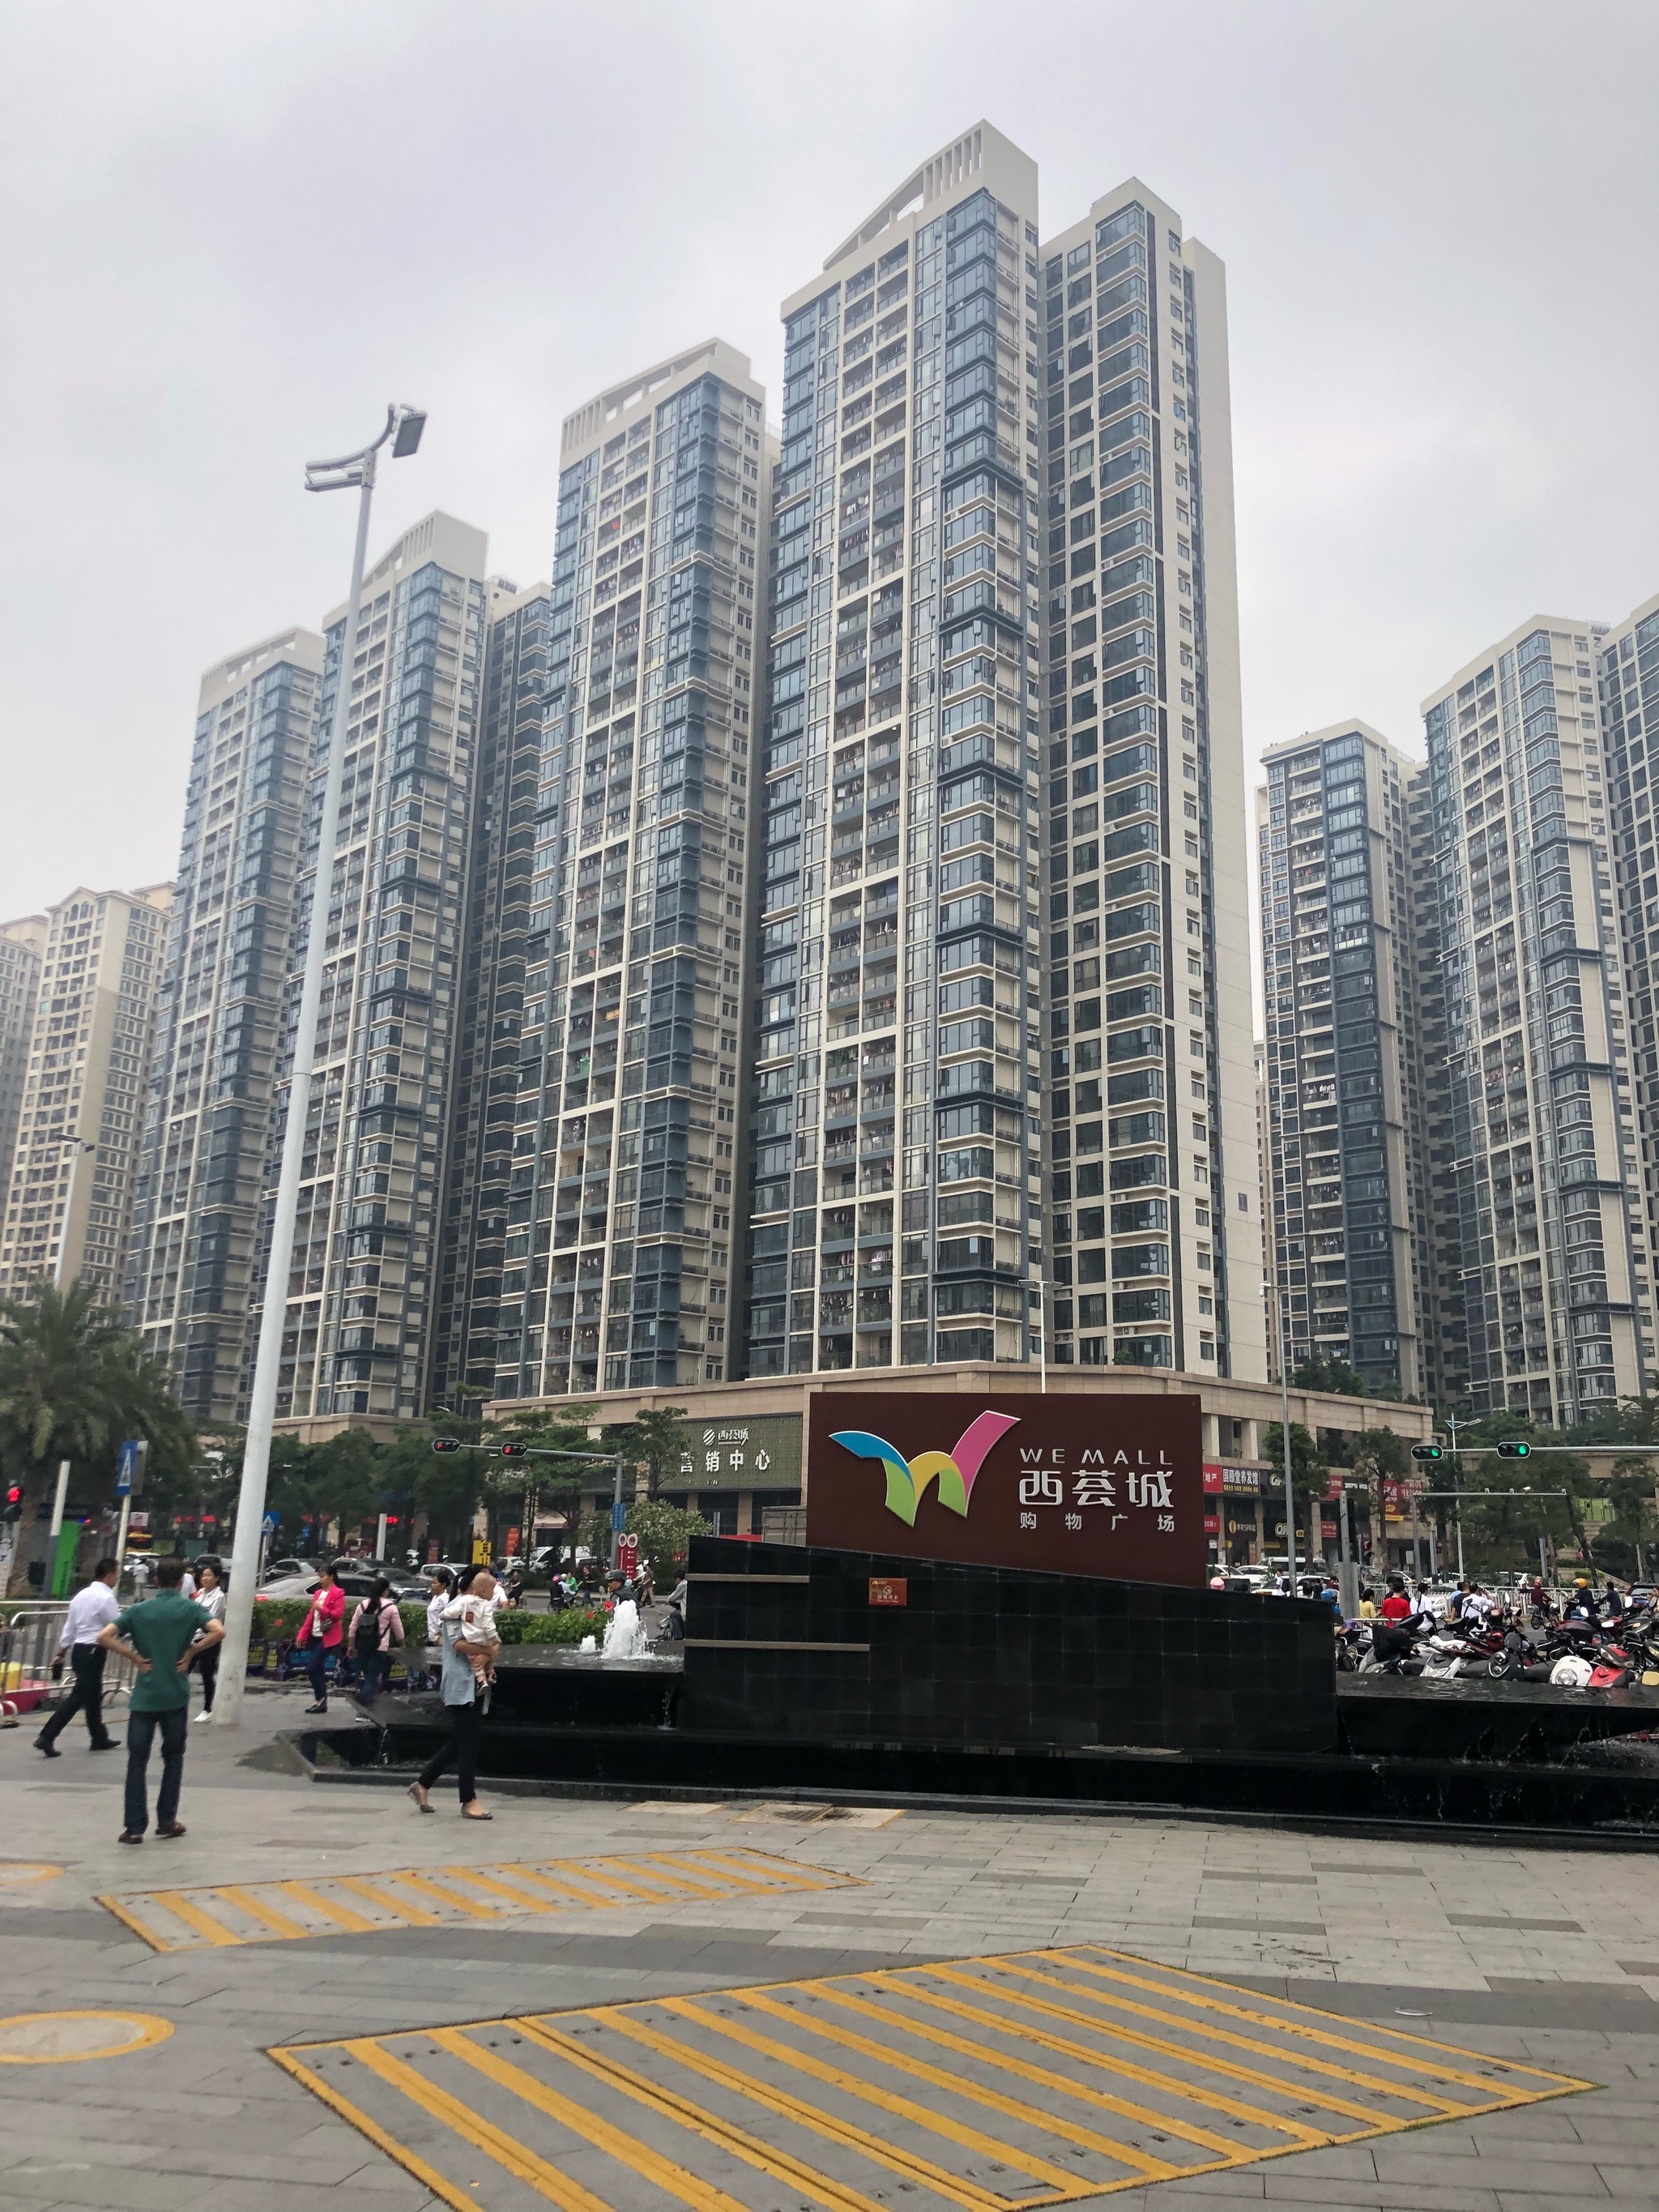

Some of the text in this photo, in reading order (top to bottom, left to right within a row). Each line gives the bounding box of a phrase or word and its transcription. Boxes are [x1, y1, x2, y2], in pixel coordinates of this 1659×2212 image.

[1019, 1448, 1173, 1465] WE MALL
[1203, 1471, 1218, 1483] 地产
[1019, 1470, 1174, 1508] 西荟城
[1020, 1512, 1175, 1532] 购物广场
